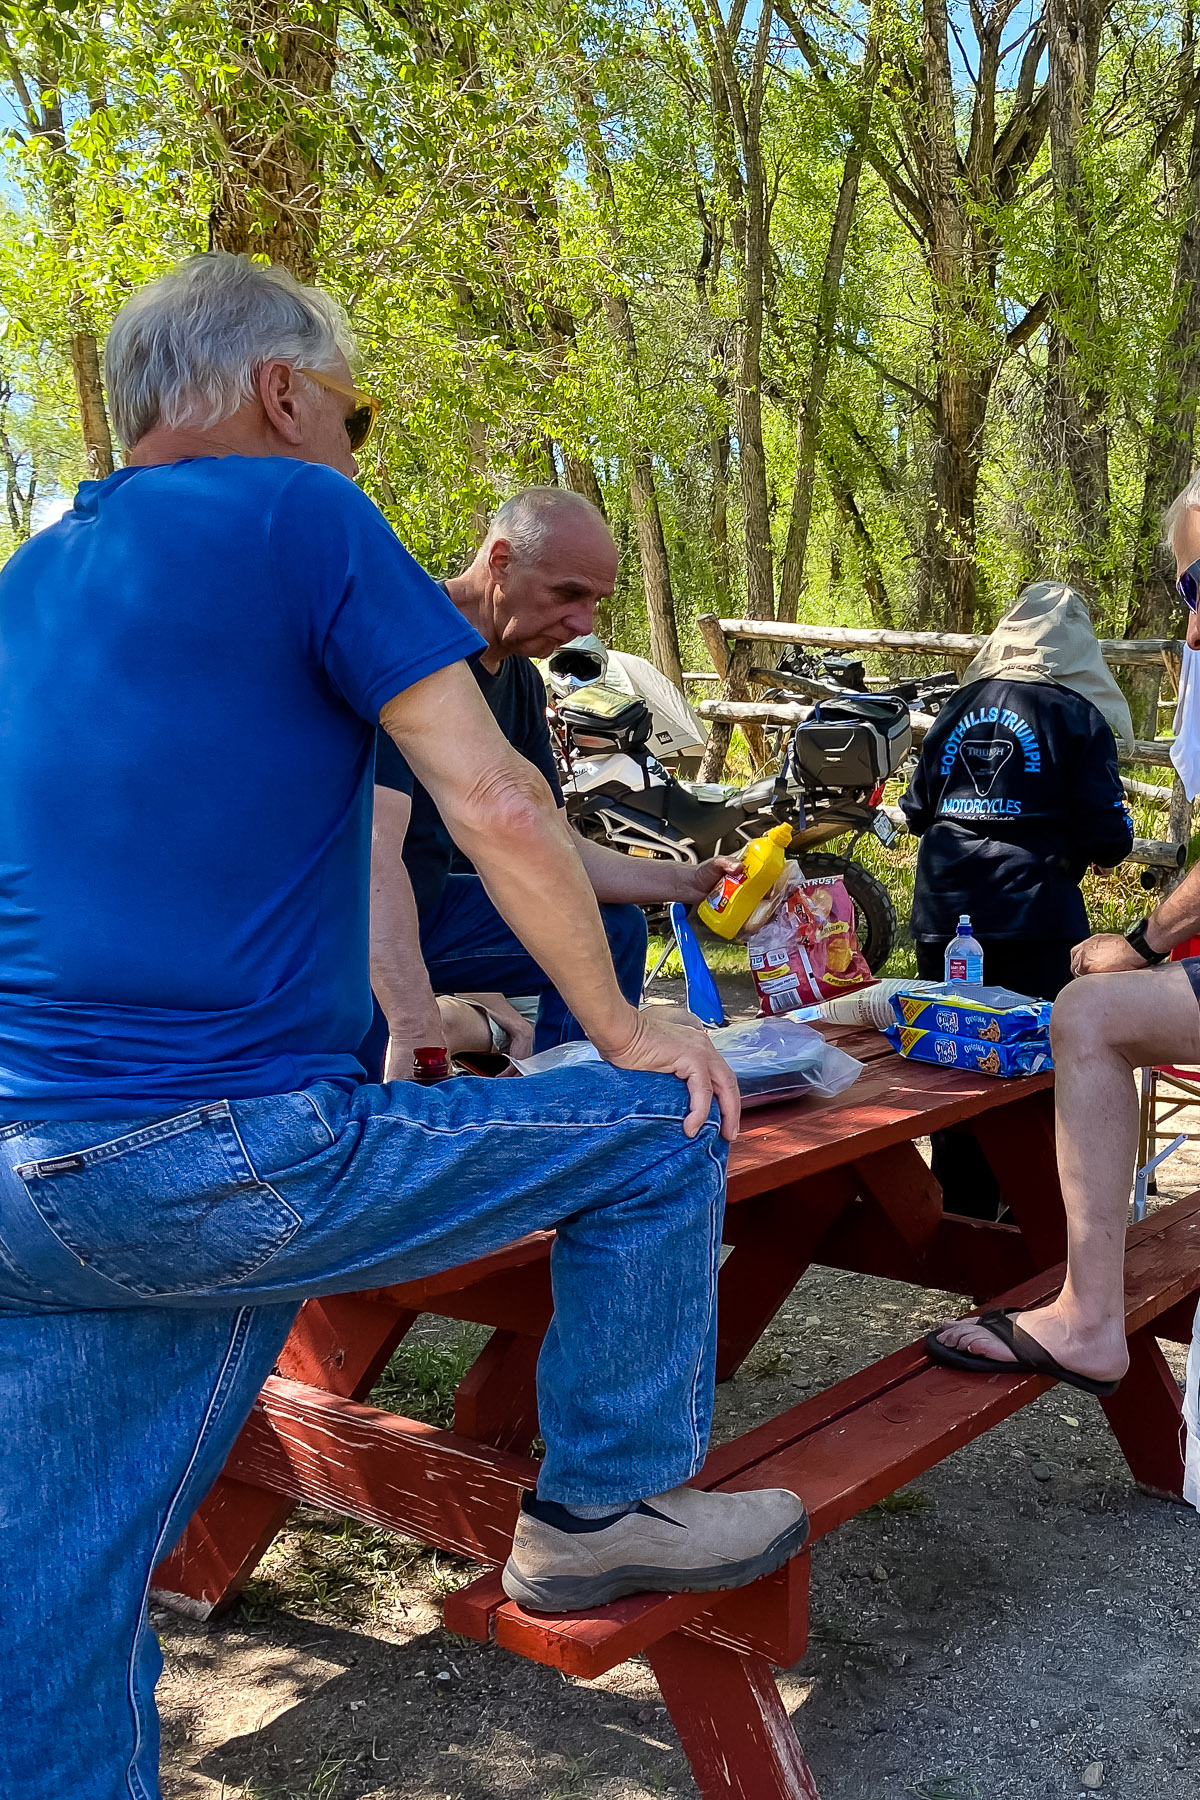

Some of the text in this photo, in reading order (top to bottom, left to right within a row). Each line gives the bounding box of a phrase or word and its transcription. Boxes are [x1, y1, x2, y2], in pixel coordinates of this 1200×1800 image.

[940, 706, 1041, 776] FOOTHILLS TRIUMPH
[966, 746, 1005, 757] TRIUMPH
[941, 798, 1022, 814] MOTORCYCLES
